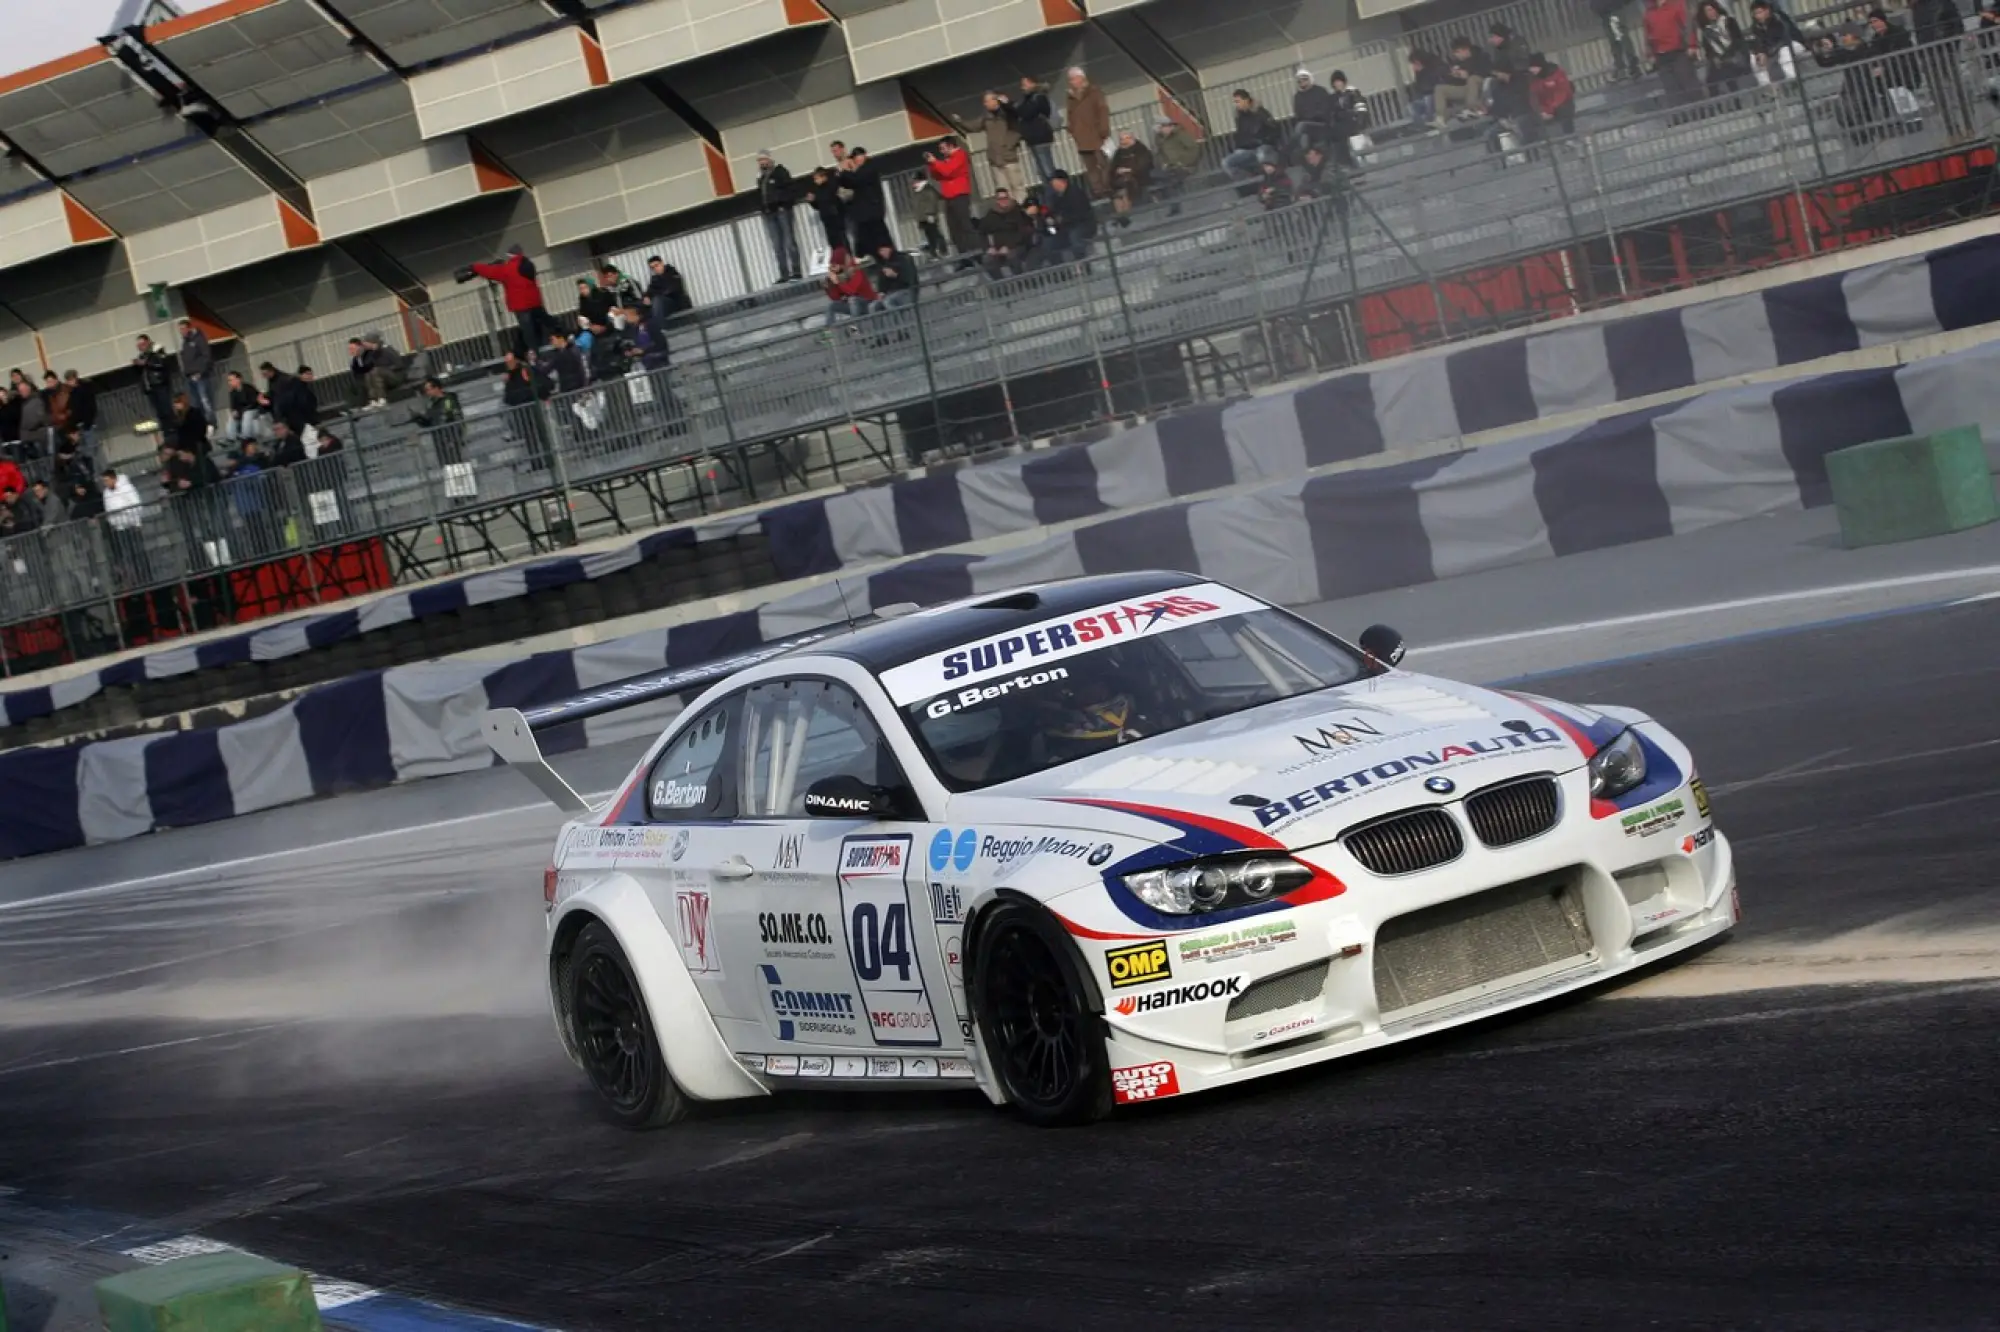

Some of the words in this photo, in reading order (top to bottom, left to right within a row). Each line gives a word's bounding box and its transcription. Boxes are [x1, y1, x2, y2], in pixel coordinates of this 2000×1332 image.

[943, 594, 1222, 682] SUPERSTARS
[926, 666, 1070, 721] G.Berton
[1253, 727, 1561, 828] BERTONAUTO
[653, 780, 707, 806] G.Berton
[806, 795, 870, 811] DINAMIC
[846, 845, 901, 868] SUPERSTARS
[981, 835, 1034, 863] Reggio
[1033, 836, 1092, 858] Motori
[759, 911, 833, 944] SO.ME.CO.
[852, 902, 911, 981] 04
[1110, 949, 1166, 978] OMP
[771, 990, 856, 1020] COMMIT
[1269, 1017, 1315, 1036] Castrol
[1114, 1064, 1171, 1082] AUTO
[1117, 1075, 1168, 1092] SPRI
[1127, 1086, 1160, 1100] NT
